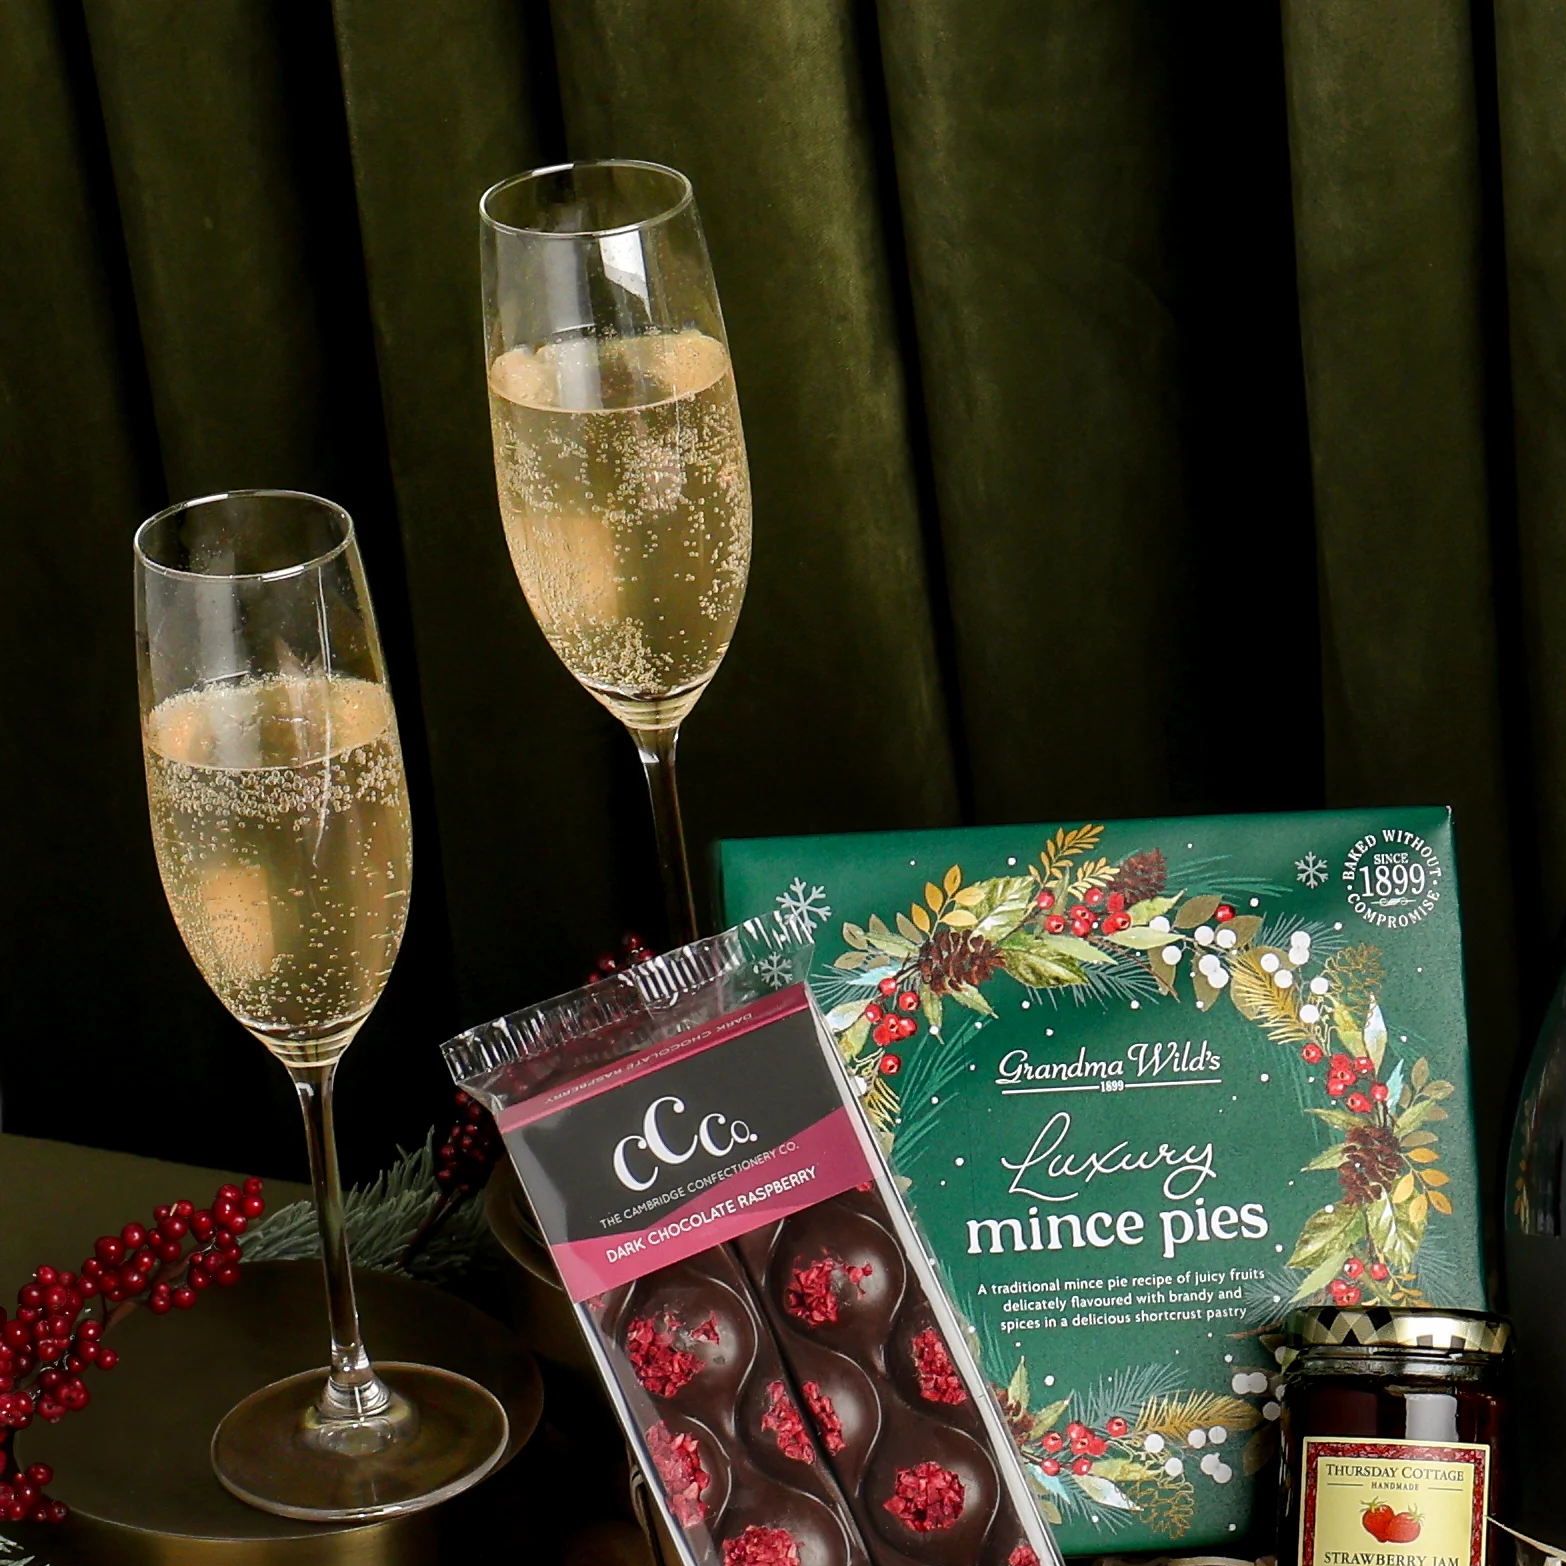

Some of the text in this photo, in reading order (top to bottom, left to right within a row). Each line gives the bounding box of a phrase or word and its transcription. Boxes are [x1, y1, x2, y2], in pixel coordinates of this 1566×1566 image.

[1343, 830, 1442, 880] BAKED WITHOUT
[1373, 853, 1409, 865] SINCE
[1359, 864, 1425, 897] 1899
[1348, 889, 1440, 929] COMPROMISE
[995, 1040, 1221, 1084] Grandma Wild's
[1100, 1080, 1124, 1092] 1899
[1001, 1111, 1217, 1202] Luxury
[599, 1140, 800, 1229] THE CAMBRIDGE CONFECTIONERY CO.
[606, 1165, 818, 1264] DARK CHOCOLATE RASPBERRY
[966, 1198, 1269, 1258] mince pies
[977, 1267, 1265, 1296] A traditional mince pie recipe of juicy fruits
[1003, 1287, 1242, 1313] delicately flavoured with brandy and
[1000, 1306, 1247, 1333] spices in a delicious shortcrust pastry
[1326, 1463, 1465, 1482] THURSDAY COTTAGE
[1371, 1481, 1420, 1491] HANDMADE
